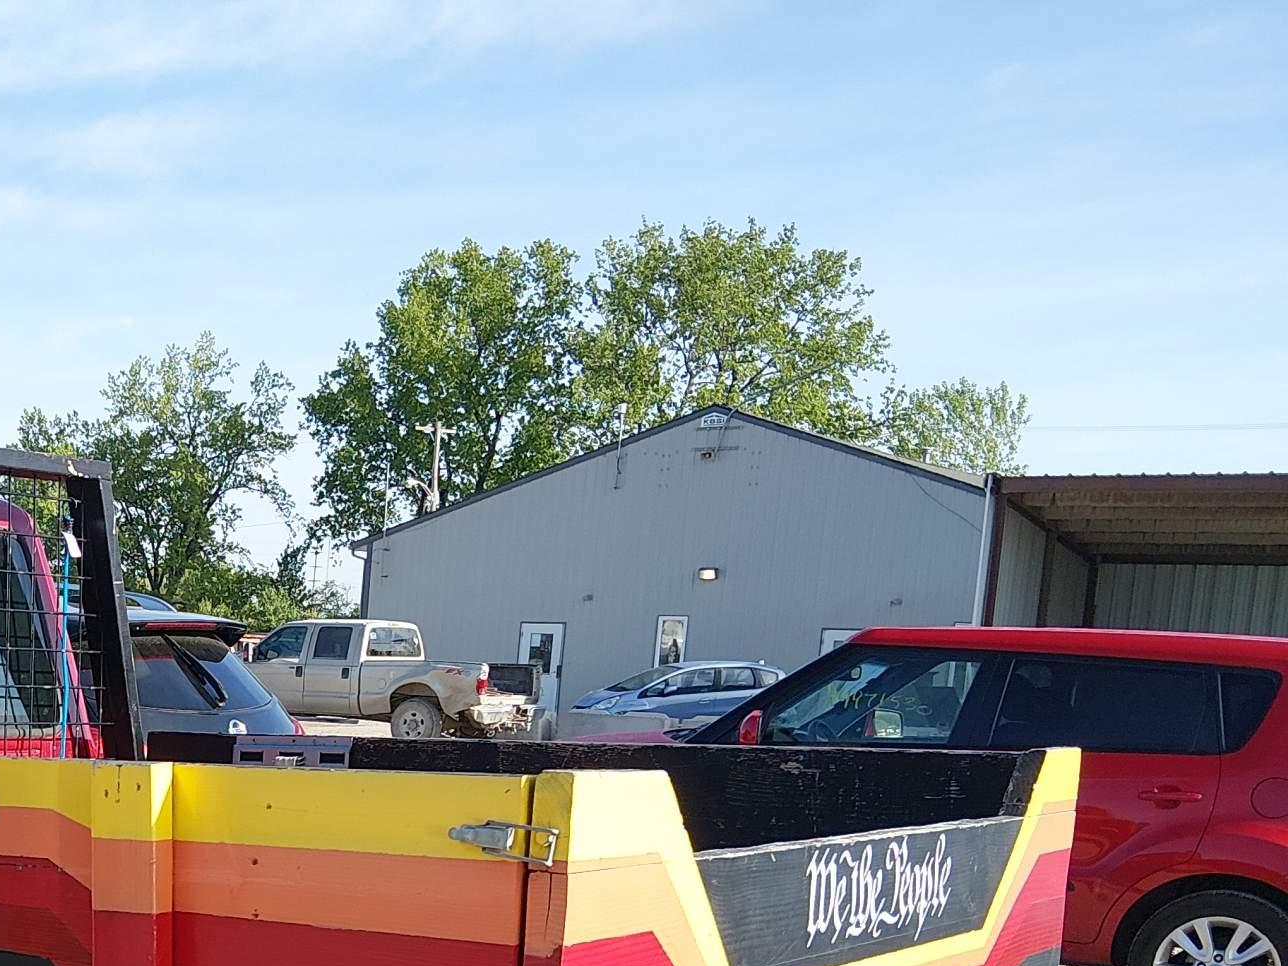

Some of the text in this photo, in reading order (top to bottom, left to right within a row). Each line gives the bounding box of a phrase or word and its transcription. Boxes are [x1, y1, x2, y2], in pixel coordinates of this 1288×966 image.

[806, 833, 952, 948] We The People
